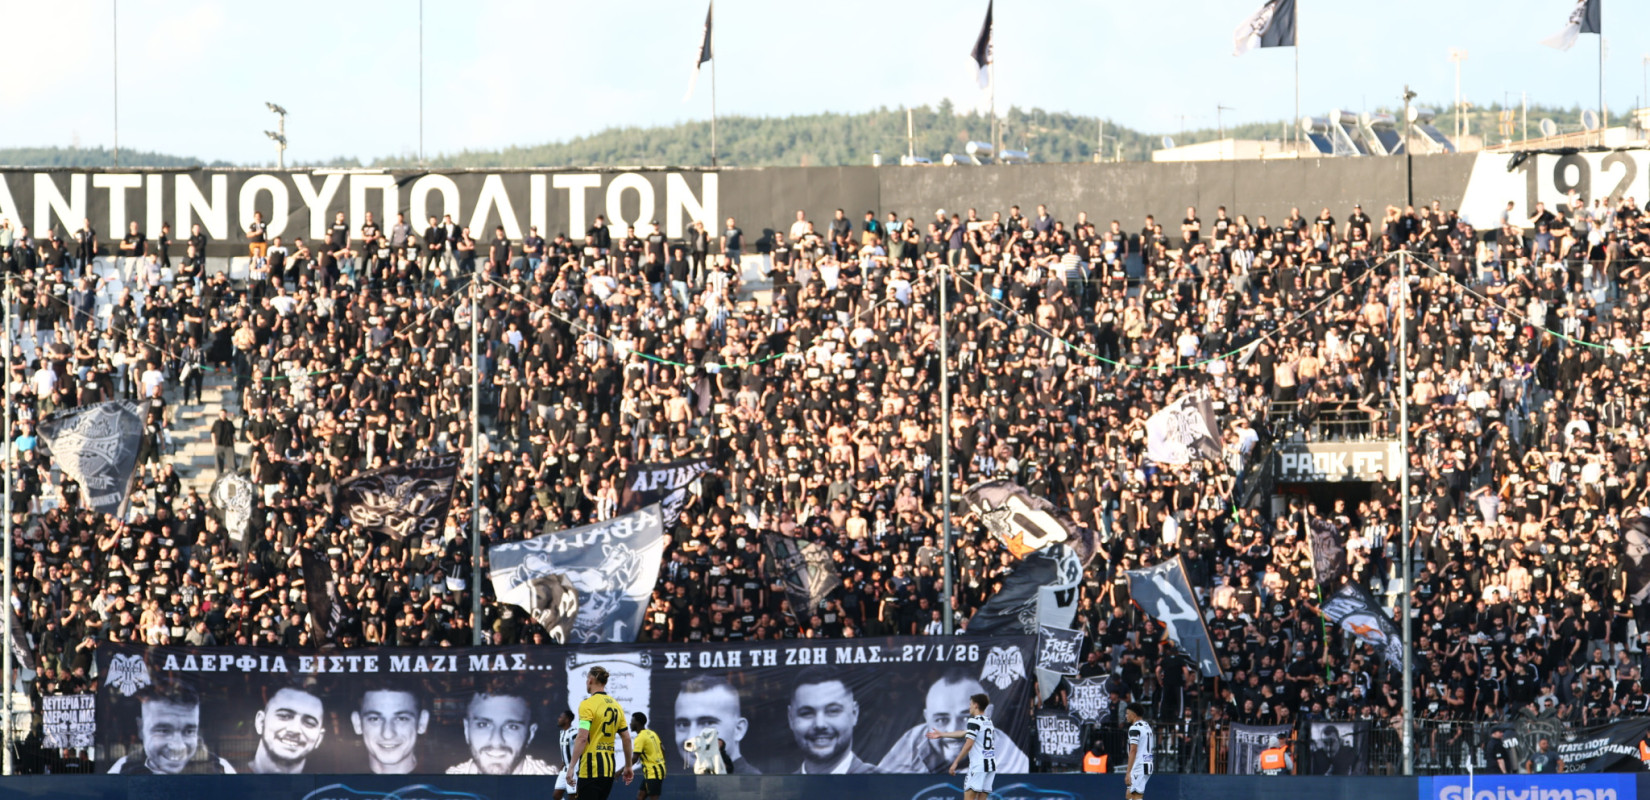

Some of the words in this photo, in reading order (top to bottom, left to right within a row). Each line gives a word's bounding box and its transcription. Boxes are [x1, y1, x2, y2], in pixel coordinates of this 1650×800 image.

[1518, 151, 1650, 219] 192
[1281, 452, 1348, 474] PAOK
[1353, 451, 1383, 473] FC
[1045, 639, 1074, 653] FREE
[162, 654, 288, 673] ΑΔΕΡΦΙΑ
[298, 655, 378, 673] ΕΙΣΤΕ
[389, 655, 457, 672] ΜΑΖΙ
[468, 653, 552, 671] ΜΑΣ...
[664, 652, 692, 669] ΣΕ
[699, 650, 741, 668] ΟΛΗ
[749, 649, 777, 666] ΤΗ
[785, 647, 827, 665] ΖΩΗ
[1041, 650, 1076, 663] DALTON
[1074, 685, 1101, 698] FREE
[1069, 697, 1108, 711] MANOS
[602, 707, 618, 737] 21
[1235, 731, 1259, 745] FREE
[1585, 738, 1610, 749] ΠΟΤΕ
